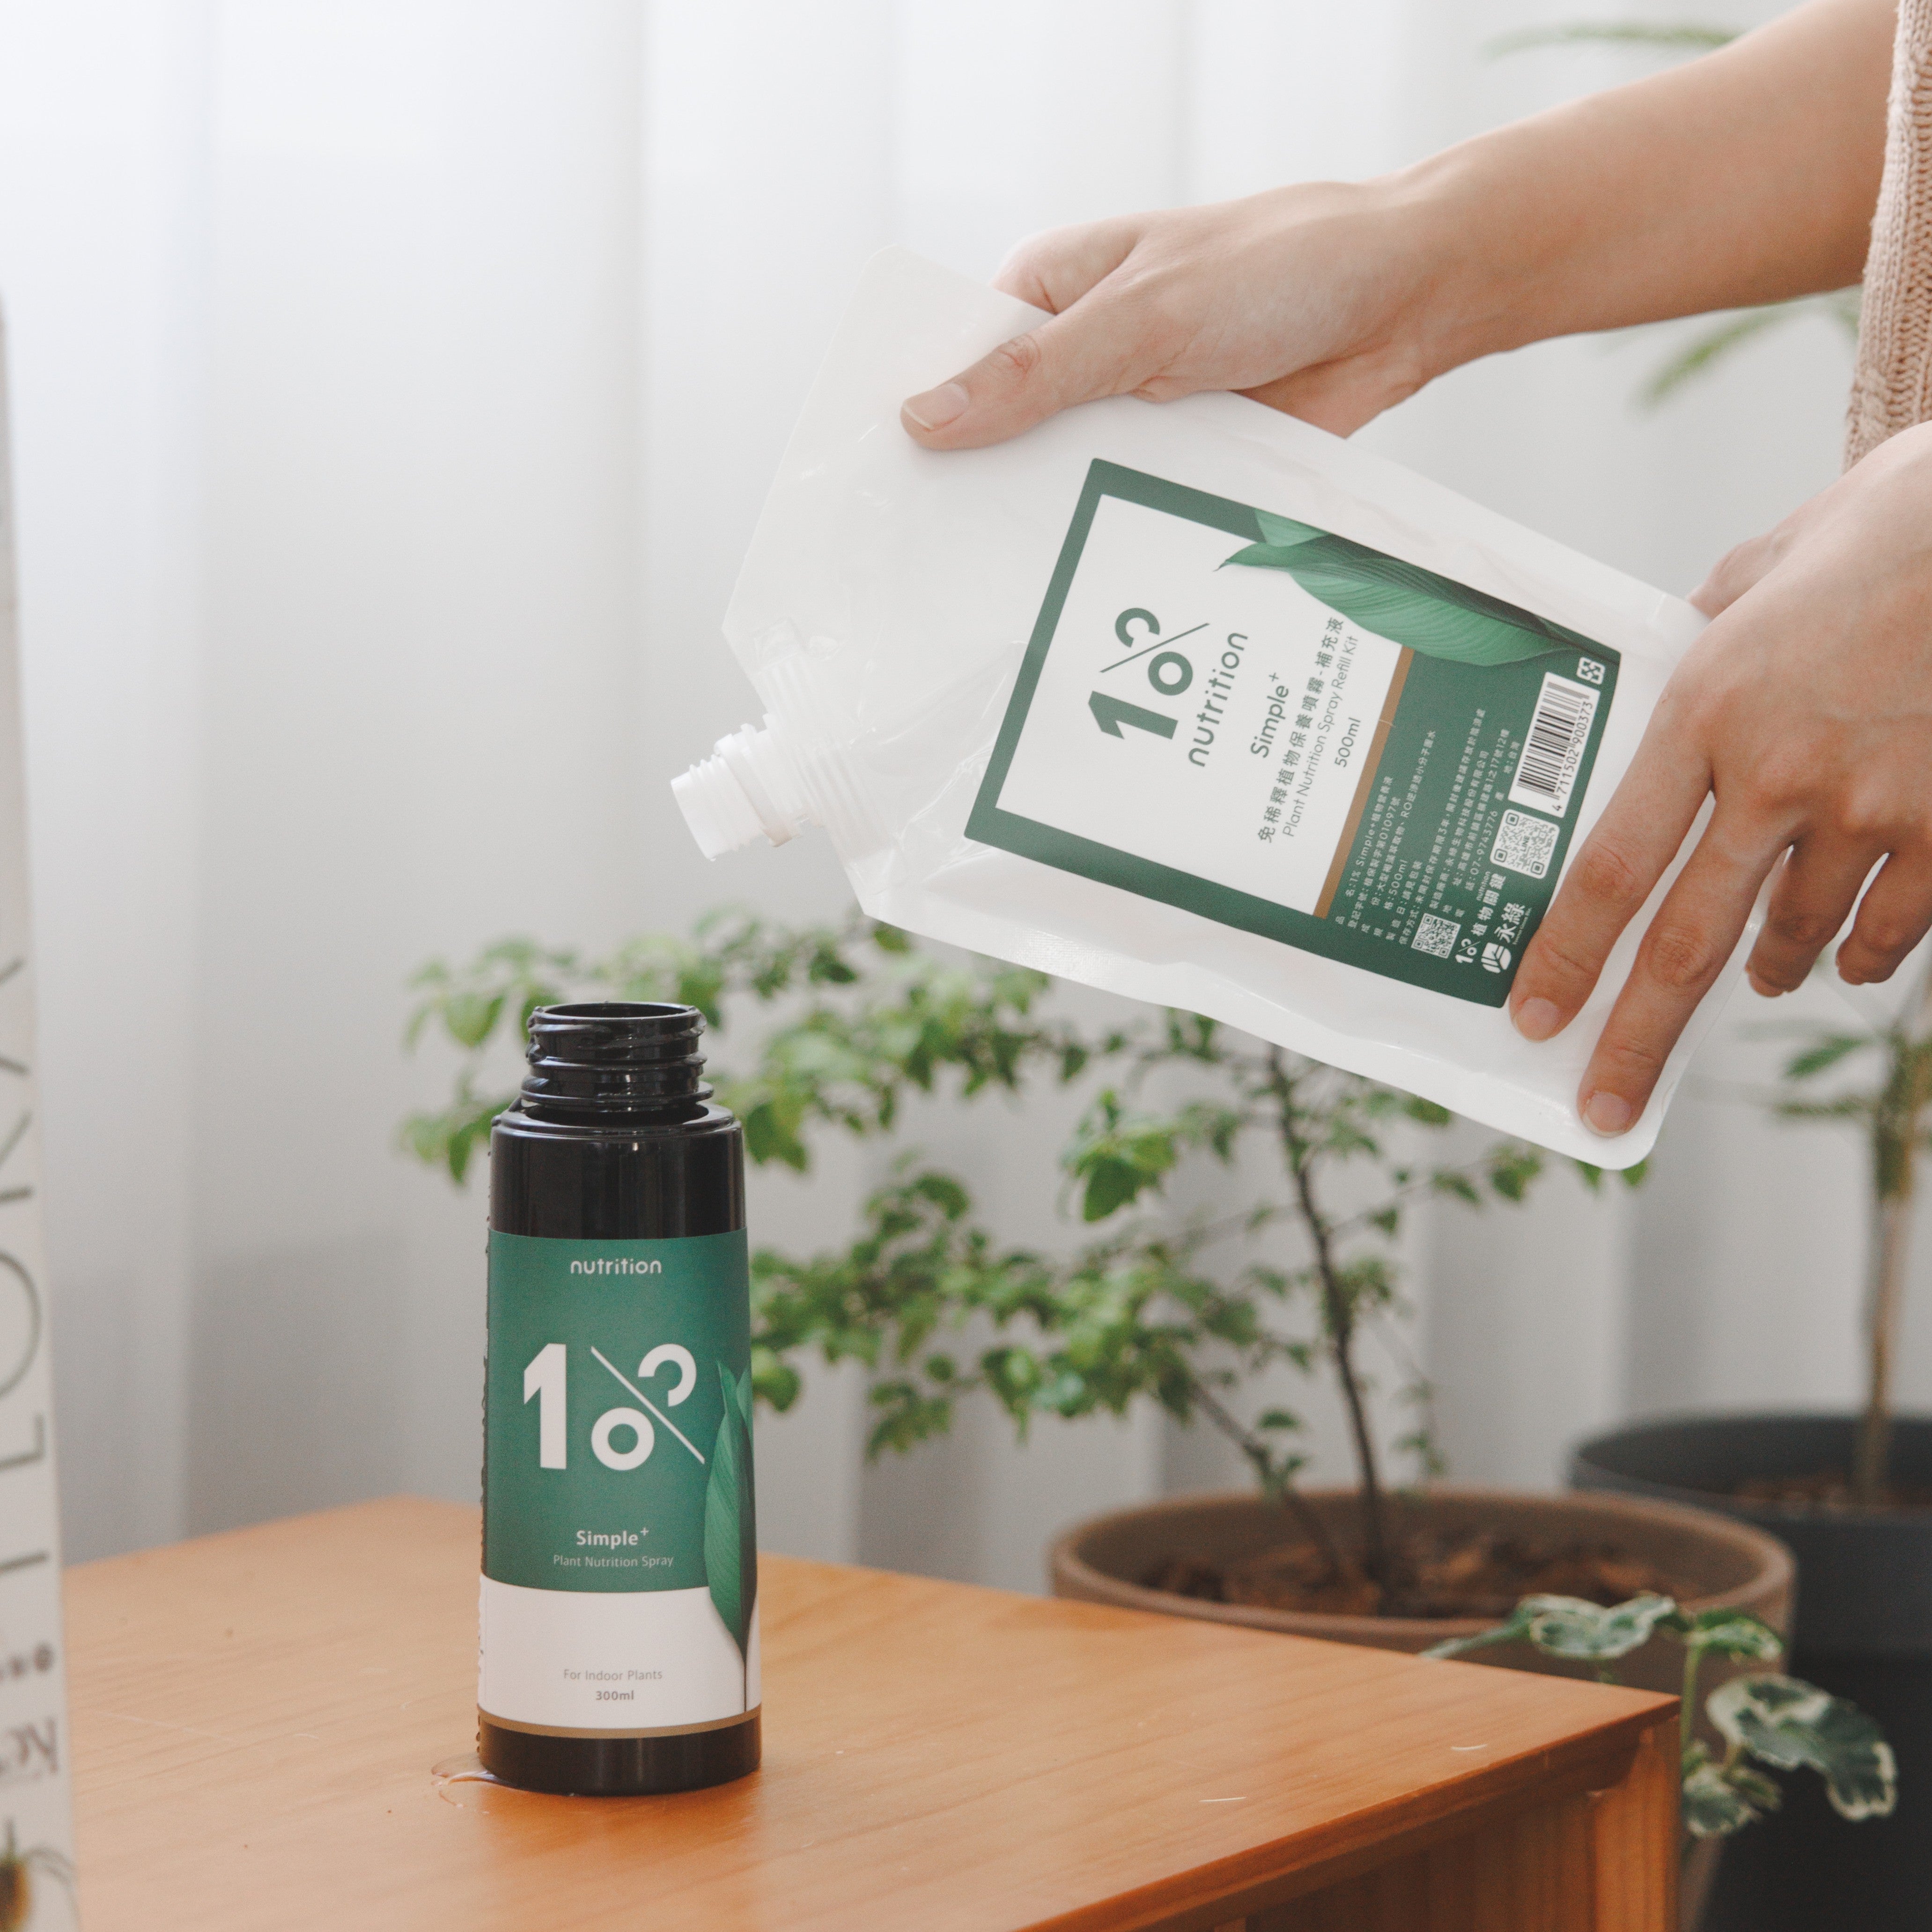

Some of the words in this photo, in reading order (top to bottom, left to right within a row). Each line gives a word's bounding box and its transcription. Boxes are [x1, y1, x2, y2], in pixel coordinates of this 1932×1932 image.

[1188, 633, 1248, 767] nutrition
[1282, 799, 1305, 837] Plant
[1296, 735, 1327, 797] Nutrition
[1317, 691, 1343, 733] Spray
[1331, 656, 1351, 690] Refill
[1342, 635, 1358, 655] Kit
[1334, 717, 1361, 768] 500ml
[1556, 749, 1579, 794] 711502
[1571, 701, 1593, 745] 900373
[1520, 835, 1530, 852] LINE
[1471, 871, 1506, 936] 植物關鍵
[1476, 870, 1491, 901] nutrition
[1494, 902, 1526, 943] 永綠
[570, 1258, 663, 1275] nutrition
[553, 1554, 581, 1567] Plant
[585, 1555, 638, 1568] Nutrition
[642, 1555, 674, 1569] Spray
[563, 1669, 581, 1681] For
[585, 1669, 623, 1681] Indoor
[627, 1669, 663, 1681] Plants
[595, 1690, 634, 1701] 300ml
